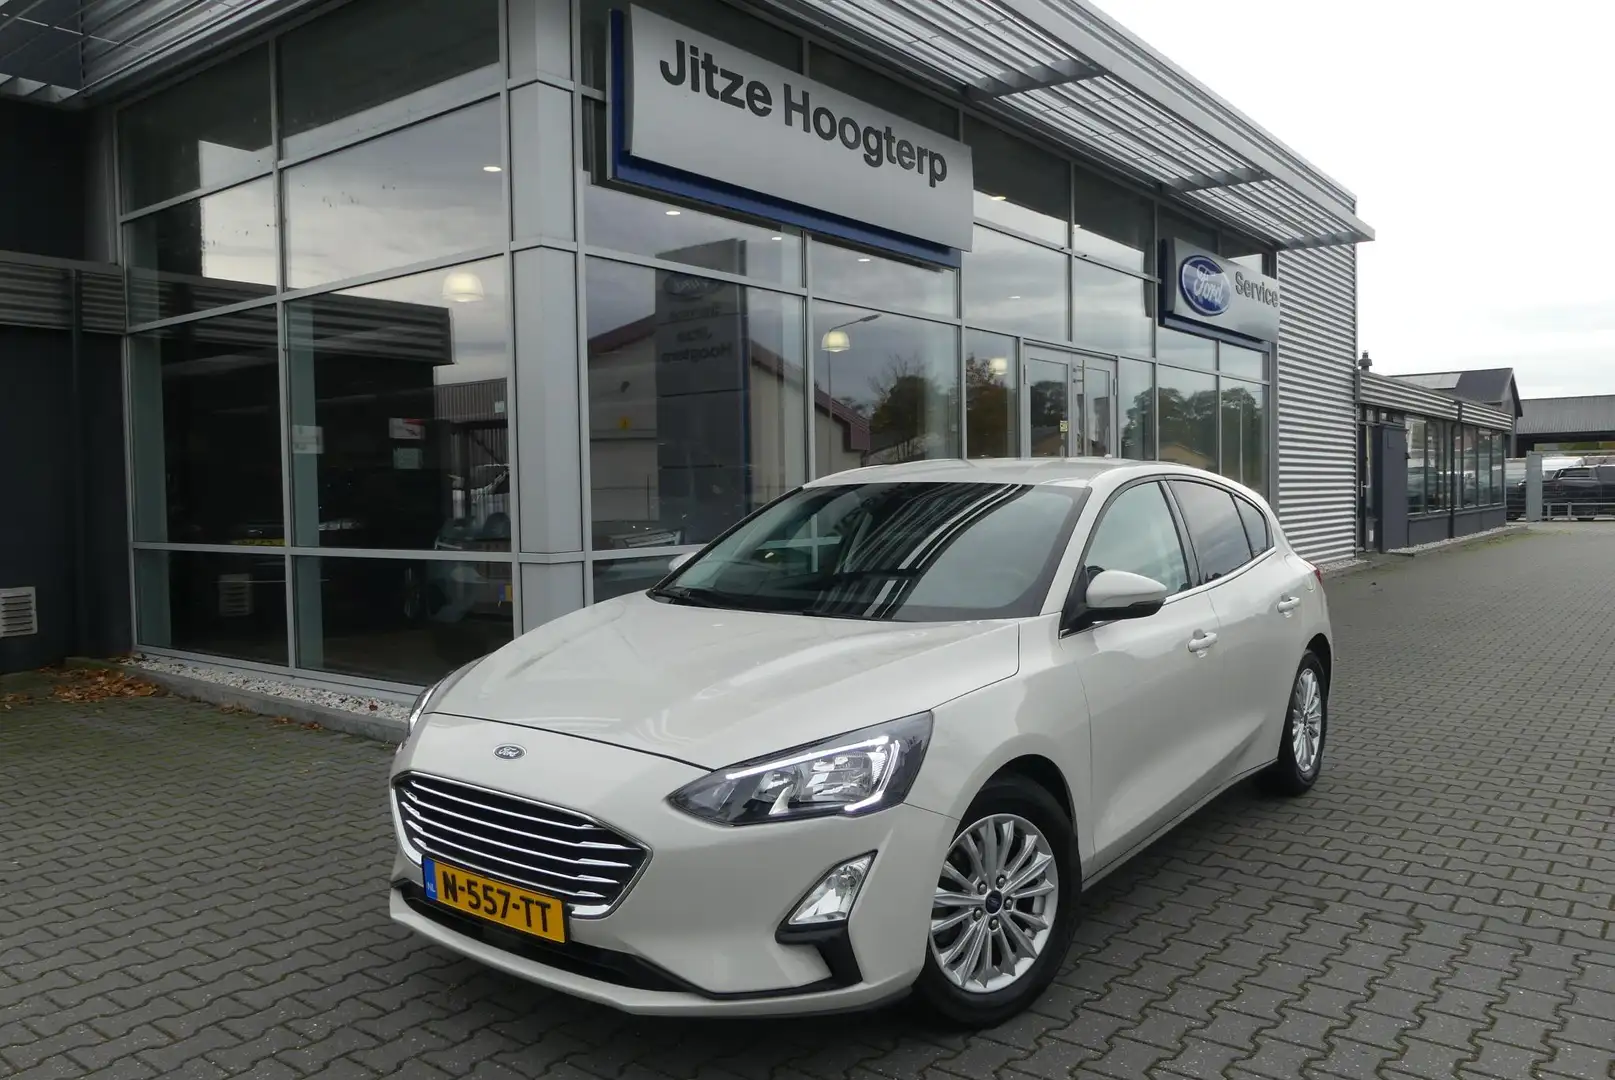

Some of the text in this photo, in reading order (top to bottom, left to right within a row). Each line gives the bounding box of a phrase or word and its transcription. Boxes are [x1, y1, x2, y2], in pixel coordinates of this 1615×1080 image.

[660, 39, 948, 188] Jitze Hoogterp
[1235, 271, 1279, 308] Service
[427, 881, 437, 893] NL
[441, 870, 552, 933] N-557-TT
